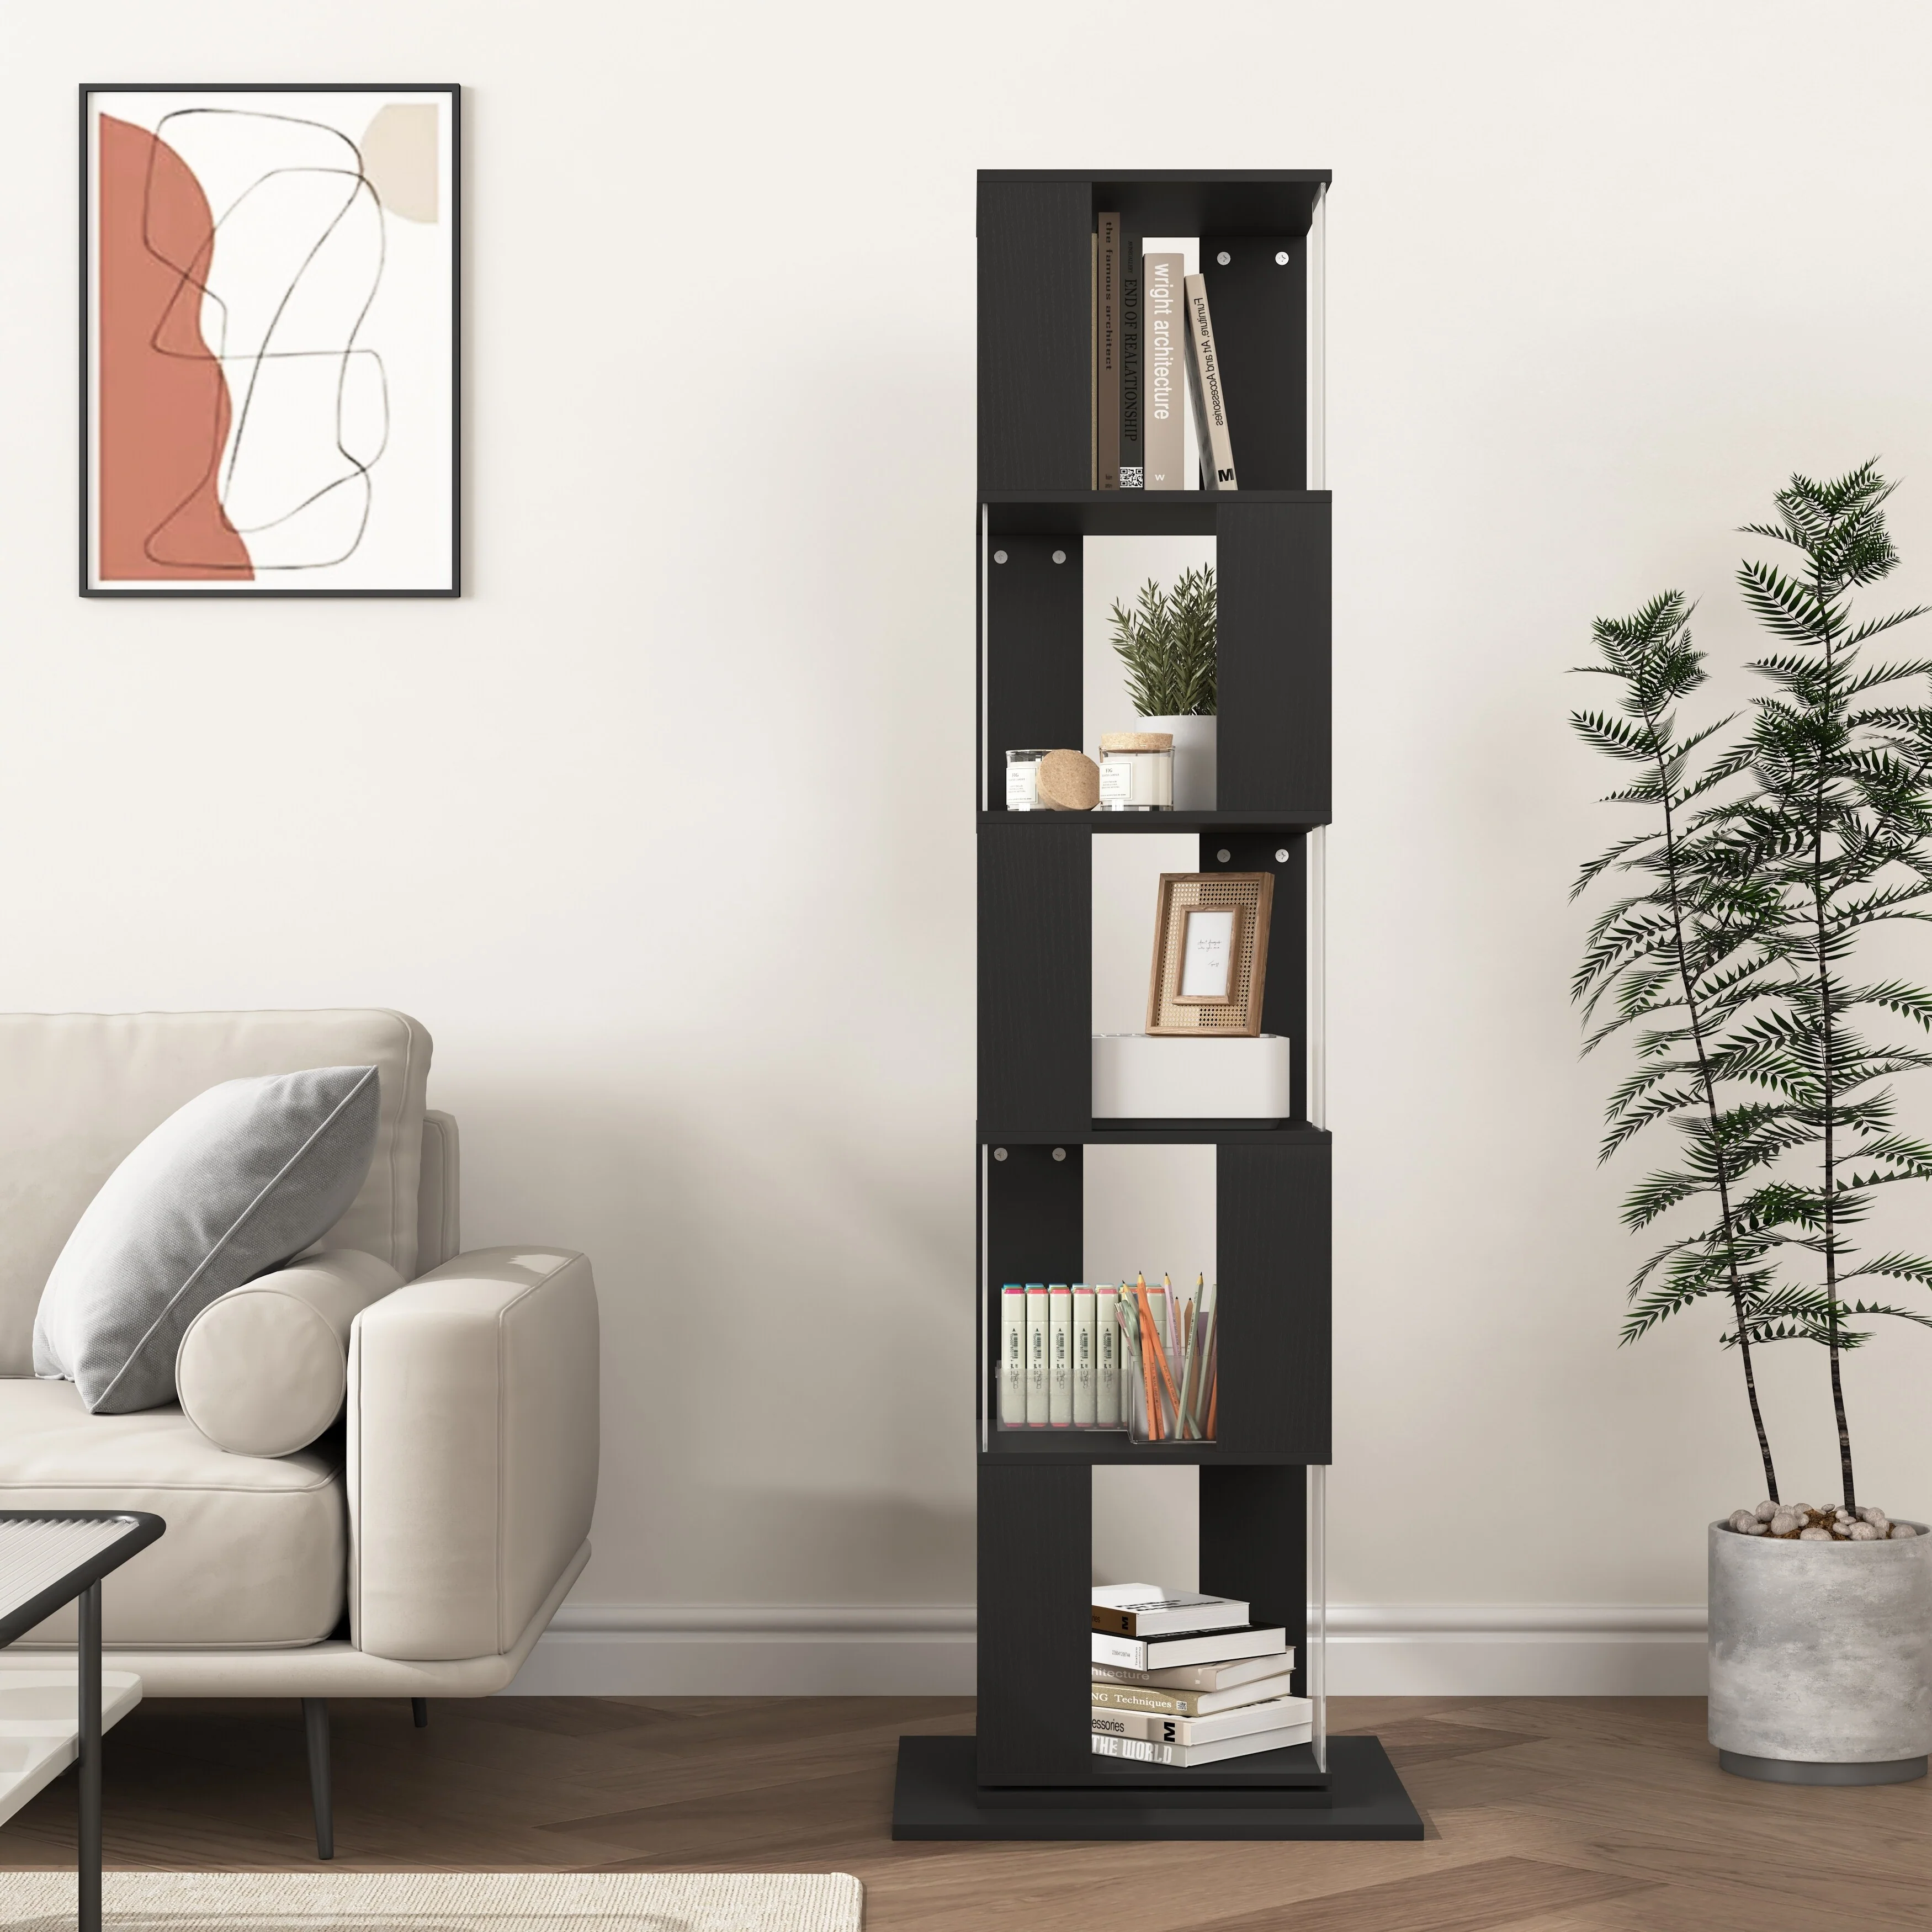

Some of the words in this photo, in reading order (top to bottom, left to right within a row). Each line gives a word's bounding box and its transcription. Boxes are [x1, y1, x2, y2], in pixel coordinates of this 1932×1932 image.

[1124, 279, 1137, 307] END
[1149, 263, 1174, 315] wright
[1124, 311, 1137, 329] OF
[1154, 320, 1174, 420] architecture
[1124, 333, 1137, 442] REALATIONSHIP
[1218, 468, 1234, 482] M
[1122, 1616, 1129, 1630] M
[1114, 1694, 1171, 1708] Techniques
[1164, 1722, 1175, 1742] M
[1092, 1734, 1118, 1756] THE
[1122, 1739, 1172, 1764] WORLD
